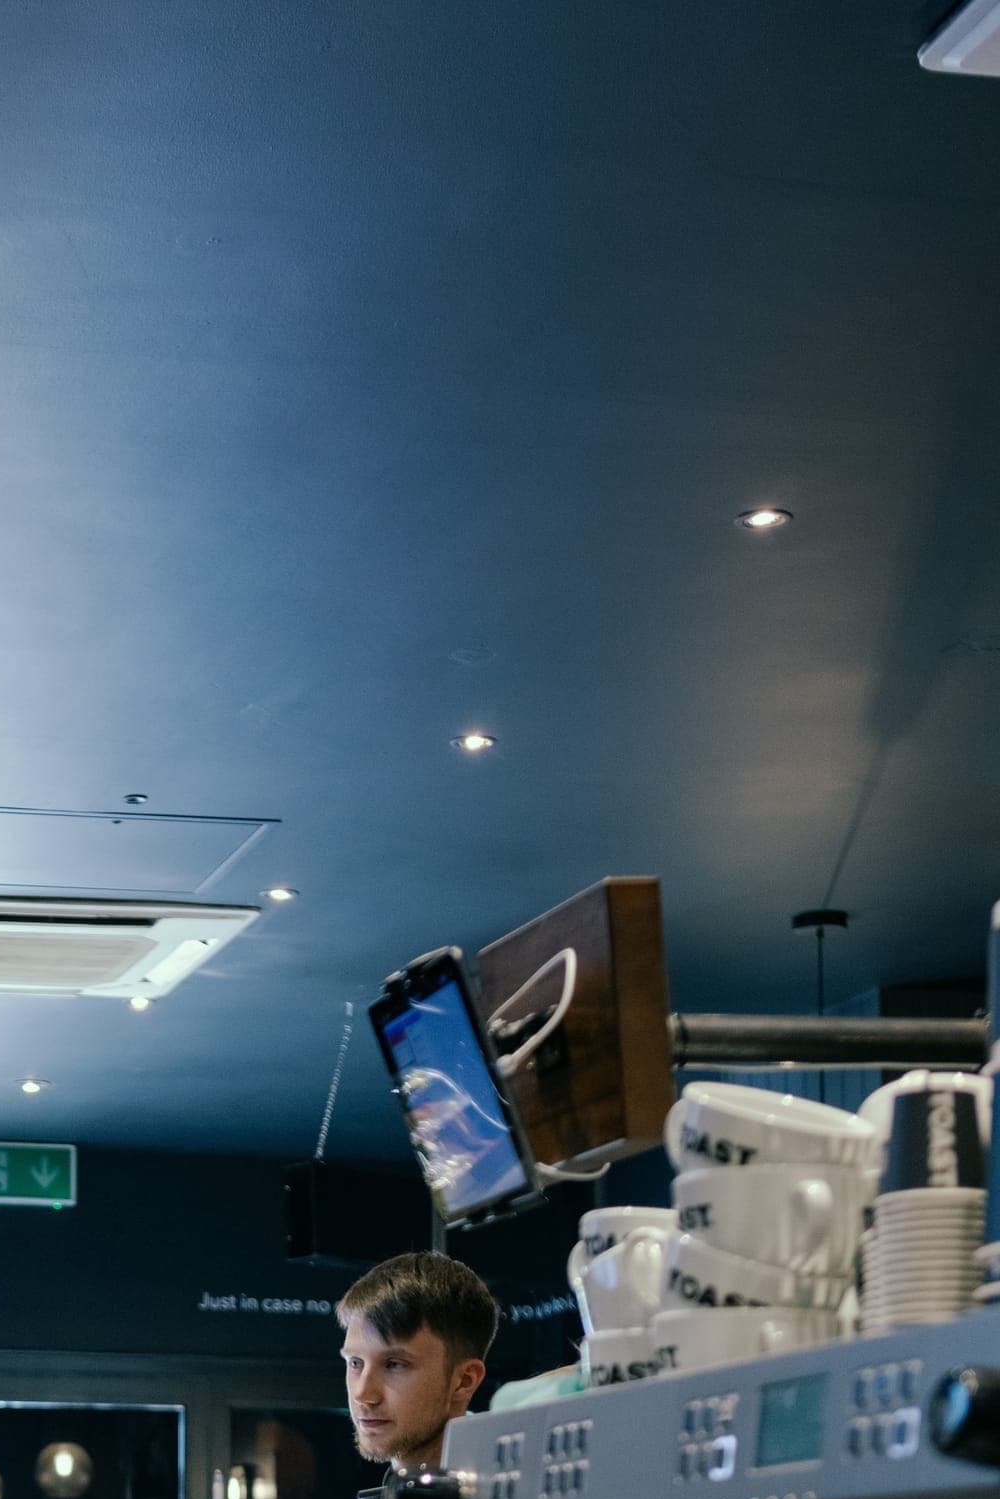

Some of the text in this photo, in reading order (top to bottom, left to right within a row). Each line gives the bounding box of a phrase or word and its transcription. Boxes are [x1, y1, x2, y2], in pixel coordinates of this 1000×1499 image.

[199, 1292, 332, 1314] Just in case no
